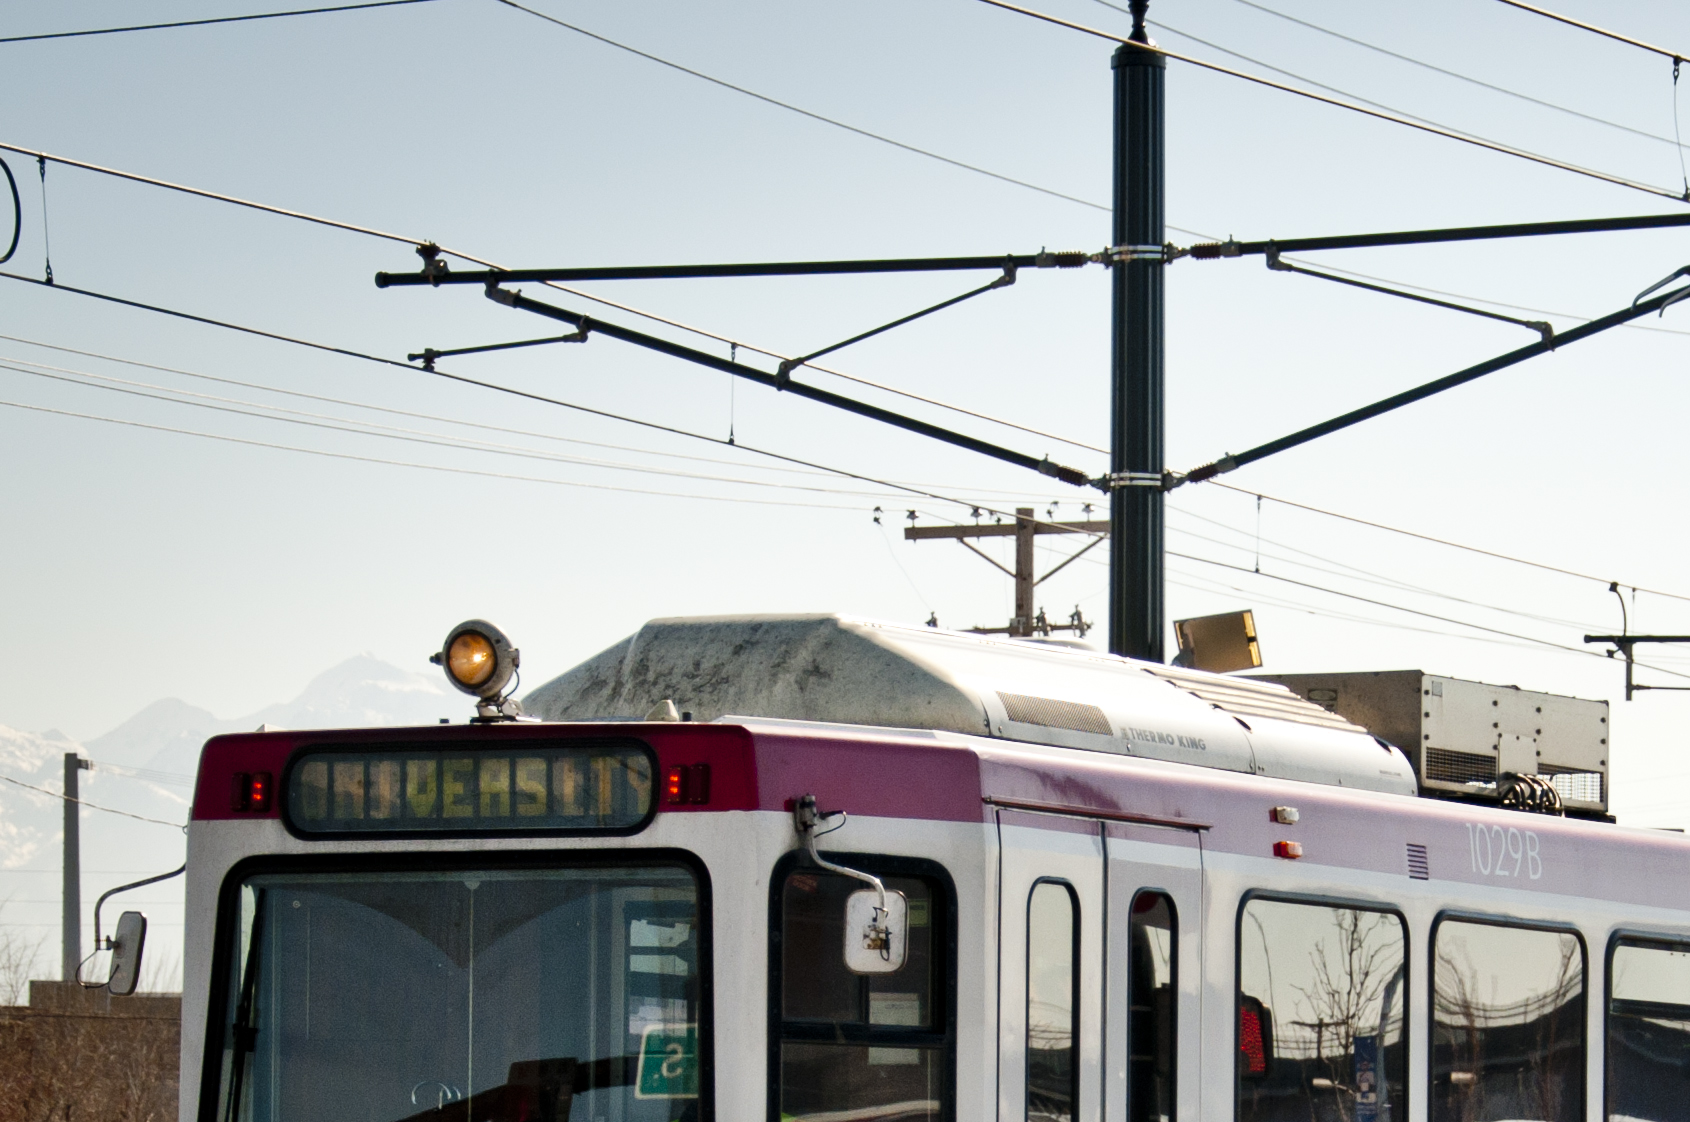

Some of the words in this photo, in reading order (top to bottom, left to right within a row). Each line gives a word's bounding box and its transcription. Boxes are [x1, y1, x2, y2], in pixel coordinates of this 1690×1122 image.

[1128, 727, 1175, 746] THERMO
[1176, 734, 1207, 751] KING
[1465, 822, 1542, 880] 1029B
